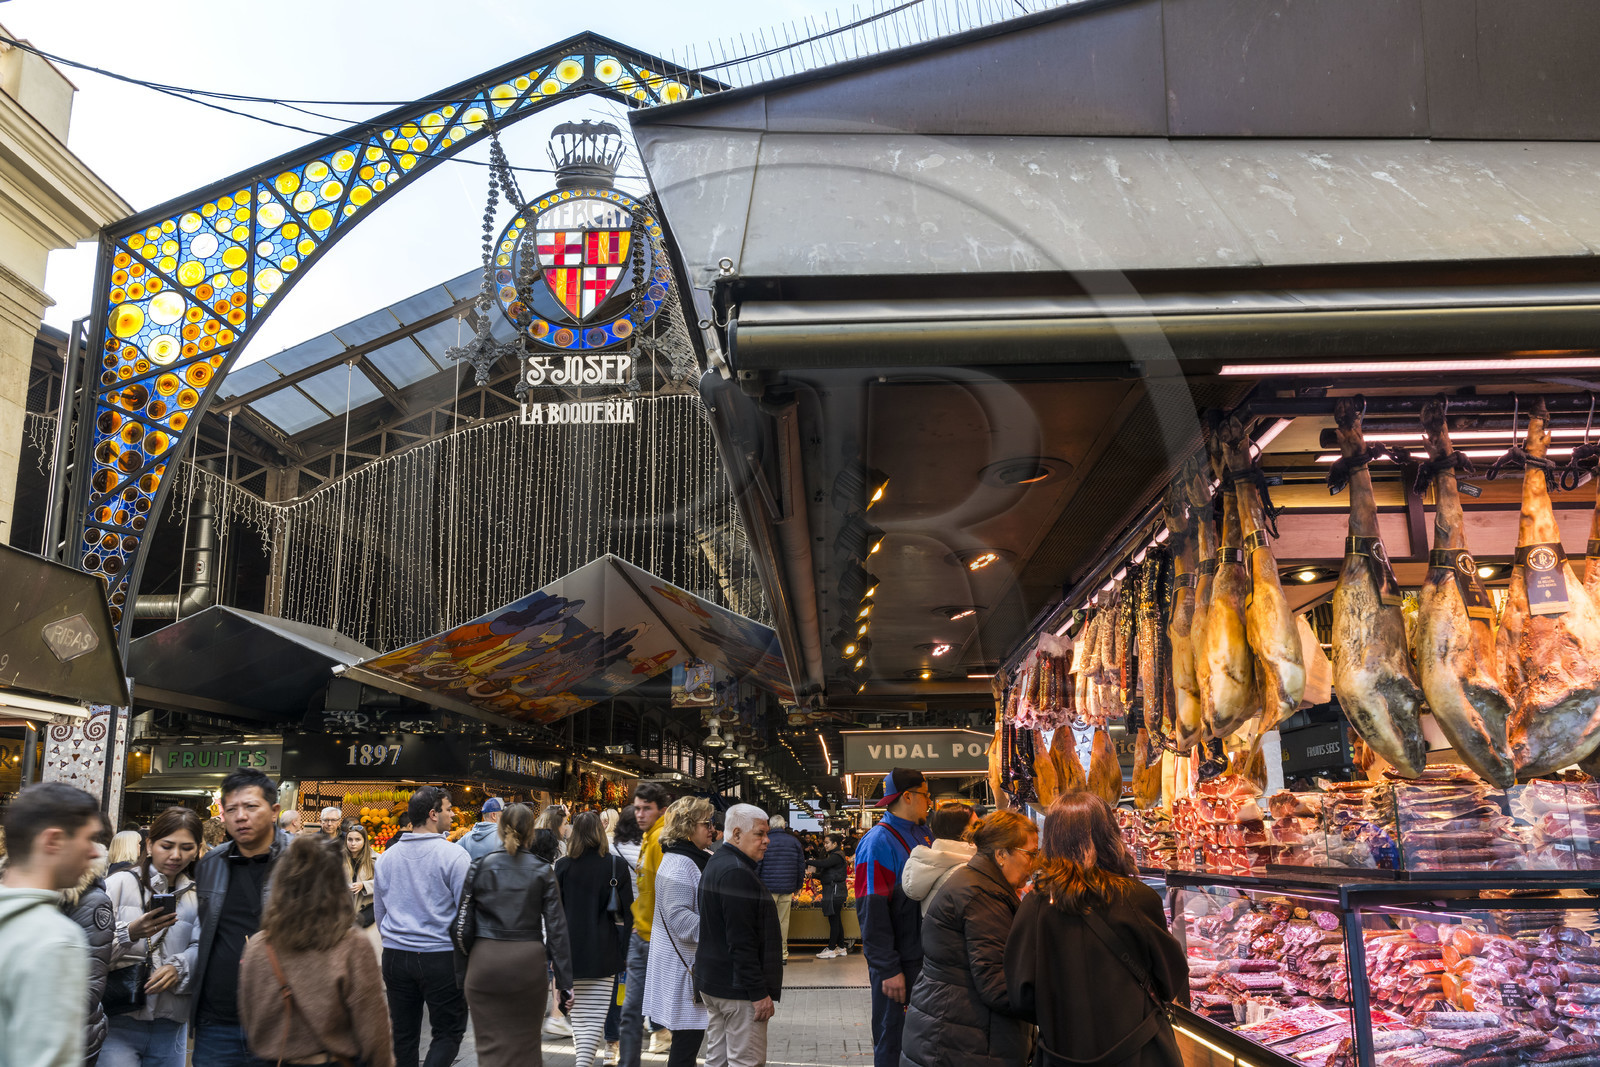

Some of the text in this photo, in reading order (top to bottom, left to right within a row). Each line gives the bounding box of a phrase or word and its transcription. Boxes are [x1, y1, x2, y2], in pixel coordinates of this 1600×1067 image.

[540, 200, 630, 229] MERCAT
[550, 355, 631, 385] JOSEP
[520, 402, 635, 424] LA BOQUERIA
[50, 625, 92, 650] RIBAS
[168, 750, 267, 768] FRUITES
[346, 743, 403, 766] 1897
[867, 743, 939, 759] VIDAL
[1306, 741, 1341, 758] FRUITS SECS
